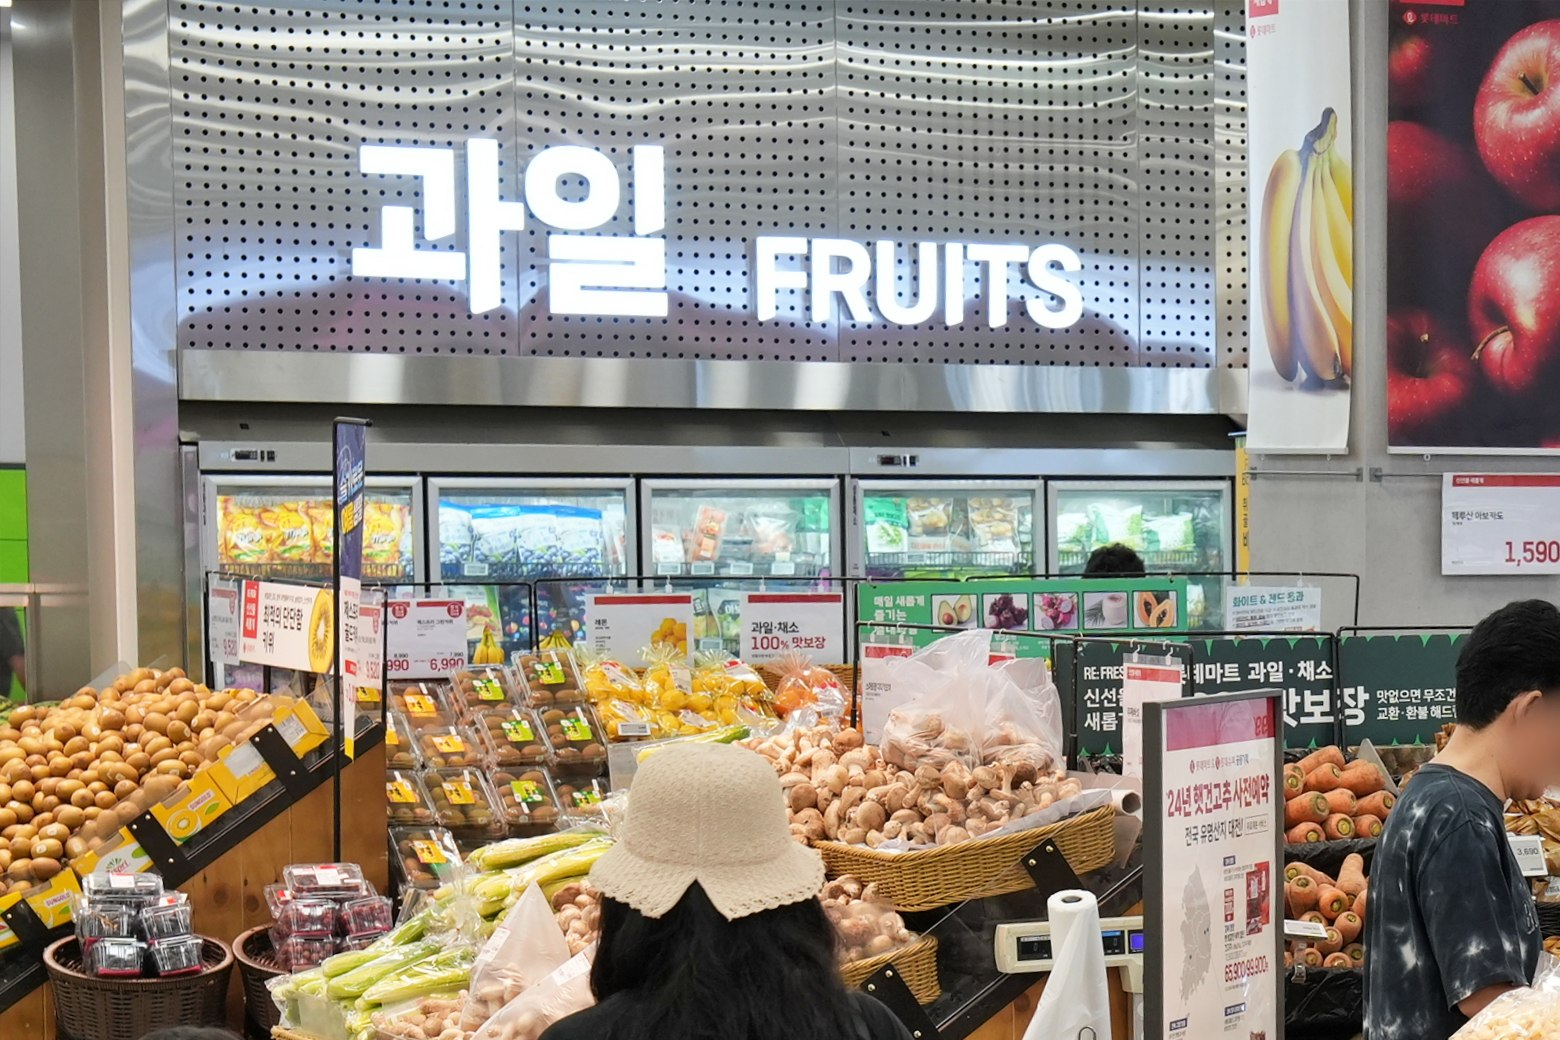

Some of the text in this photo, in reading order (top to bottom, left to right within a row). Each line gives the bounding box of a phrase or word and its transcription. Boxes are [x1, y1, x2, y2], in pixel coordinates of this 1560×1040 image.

[352, 138, 668, 316] 과일
[755, 235, 1083, 330] FRUITS
[1505, 541, 1560, 567] 1,590
[1232, 595, 1258, 608] 화이트
[263, 604, 303, 631] 최적의 단단함
[751, 620, 800, 635] 과일·채소
[263, 631, 275, 654] 키위
[751, 635, 826, 650] 100% 맛보장
[387, 659, 410, 672] 990
[429, 658, 465, 673] 6,990
[1083, 666, 1124, 681] RE:FRES
[1376, 687, 1457, 704] 맛없으면 무조건
[1083, 711, 1124, 732] 새롭
[1167, 773, 1270, 819] 24년 햇건고추 사전예약
